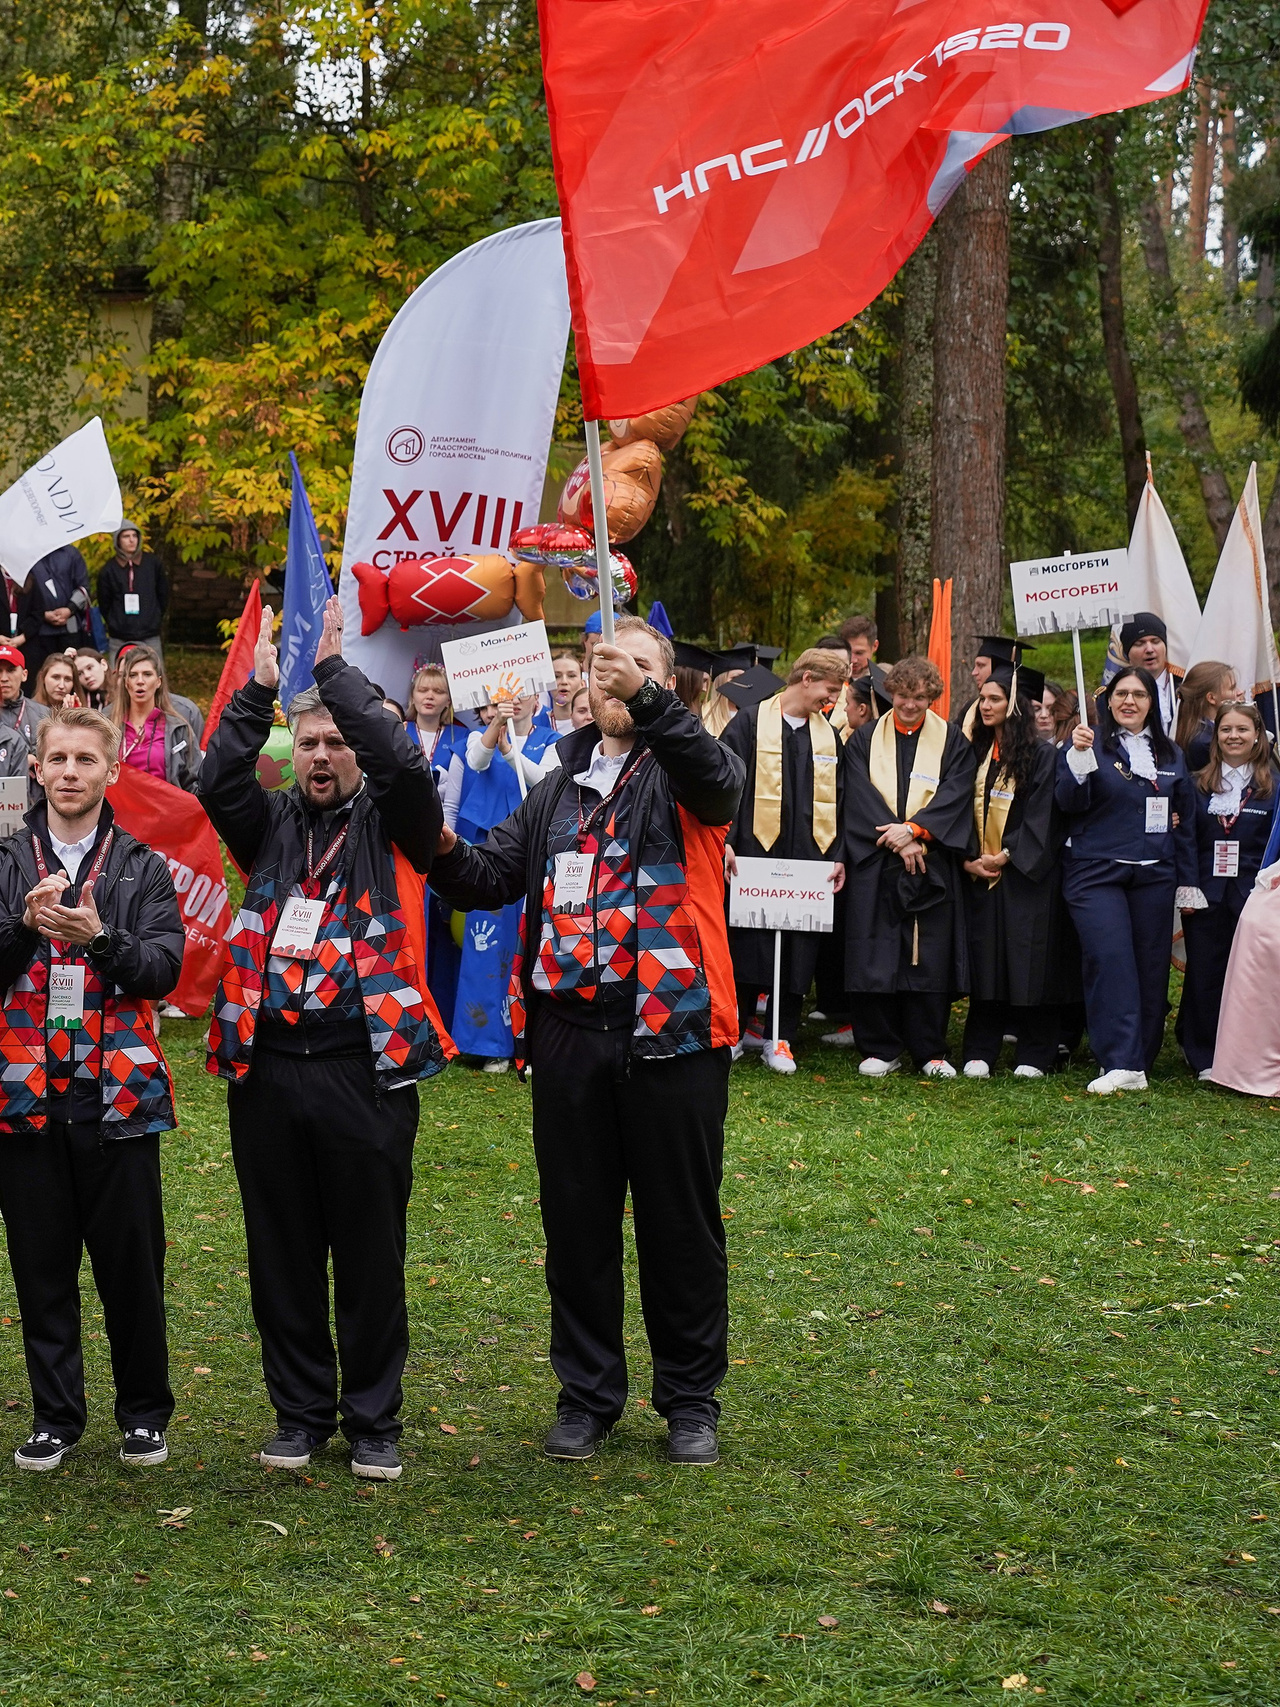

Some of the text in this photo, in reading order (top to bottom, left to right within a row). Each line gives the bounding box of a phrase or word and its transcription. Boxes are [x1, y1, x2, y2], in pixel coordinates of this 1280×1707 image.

[929, 22, 1070, 68] 1520
[430, 436, 476, 444] ДЕПАРТАМЕНТ
[430, 444, 532, 462] ГРАДОСТРОИТЕЛЬНОЙ ПОЛИТИКИ
[458, 453, 486, 461] МОСКВЫ
[376, 488, 523, 551] XVIII
[1042, 558, 1109, 575] МОСГОРБТИ
[1026, 582, 1119, 603] МОСГОРБТИ
[453, 651, 546, 680] МОНАРХ-ПРОЕКТ
[313, 860, 327, 879] ГОРОДА
[739, 887, 825, 900] МОНАРХ-УКС
[291, 910, 312, 918] XVIII
[52, 978, 73, 986] XVIII
